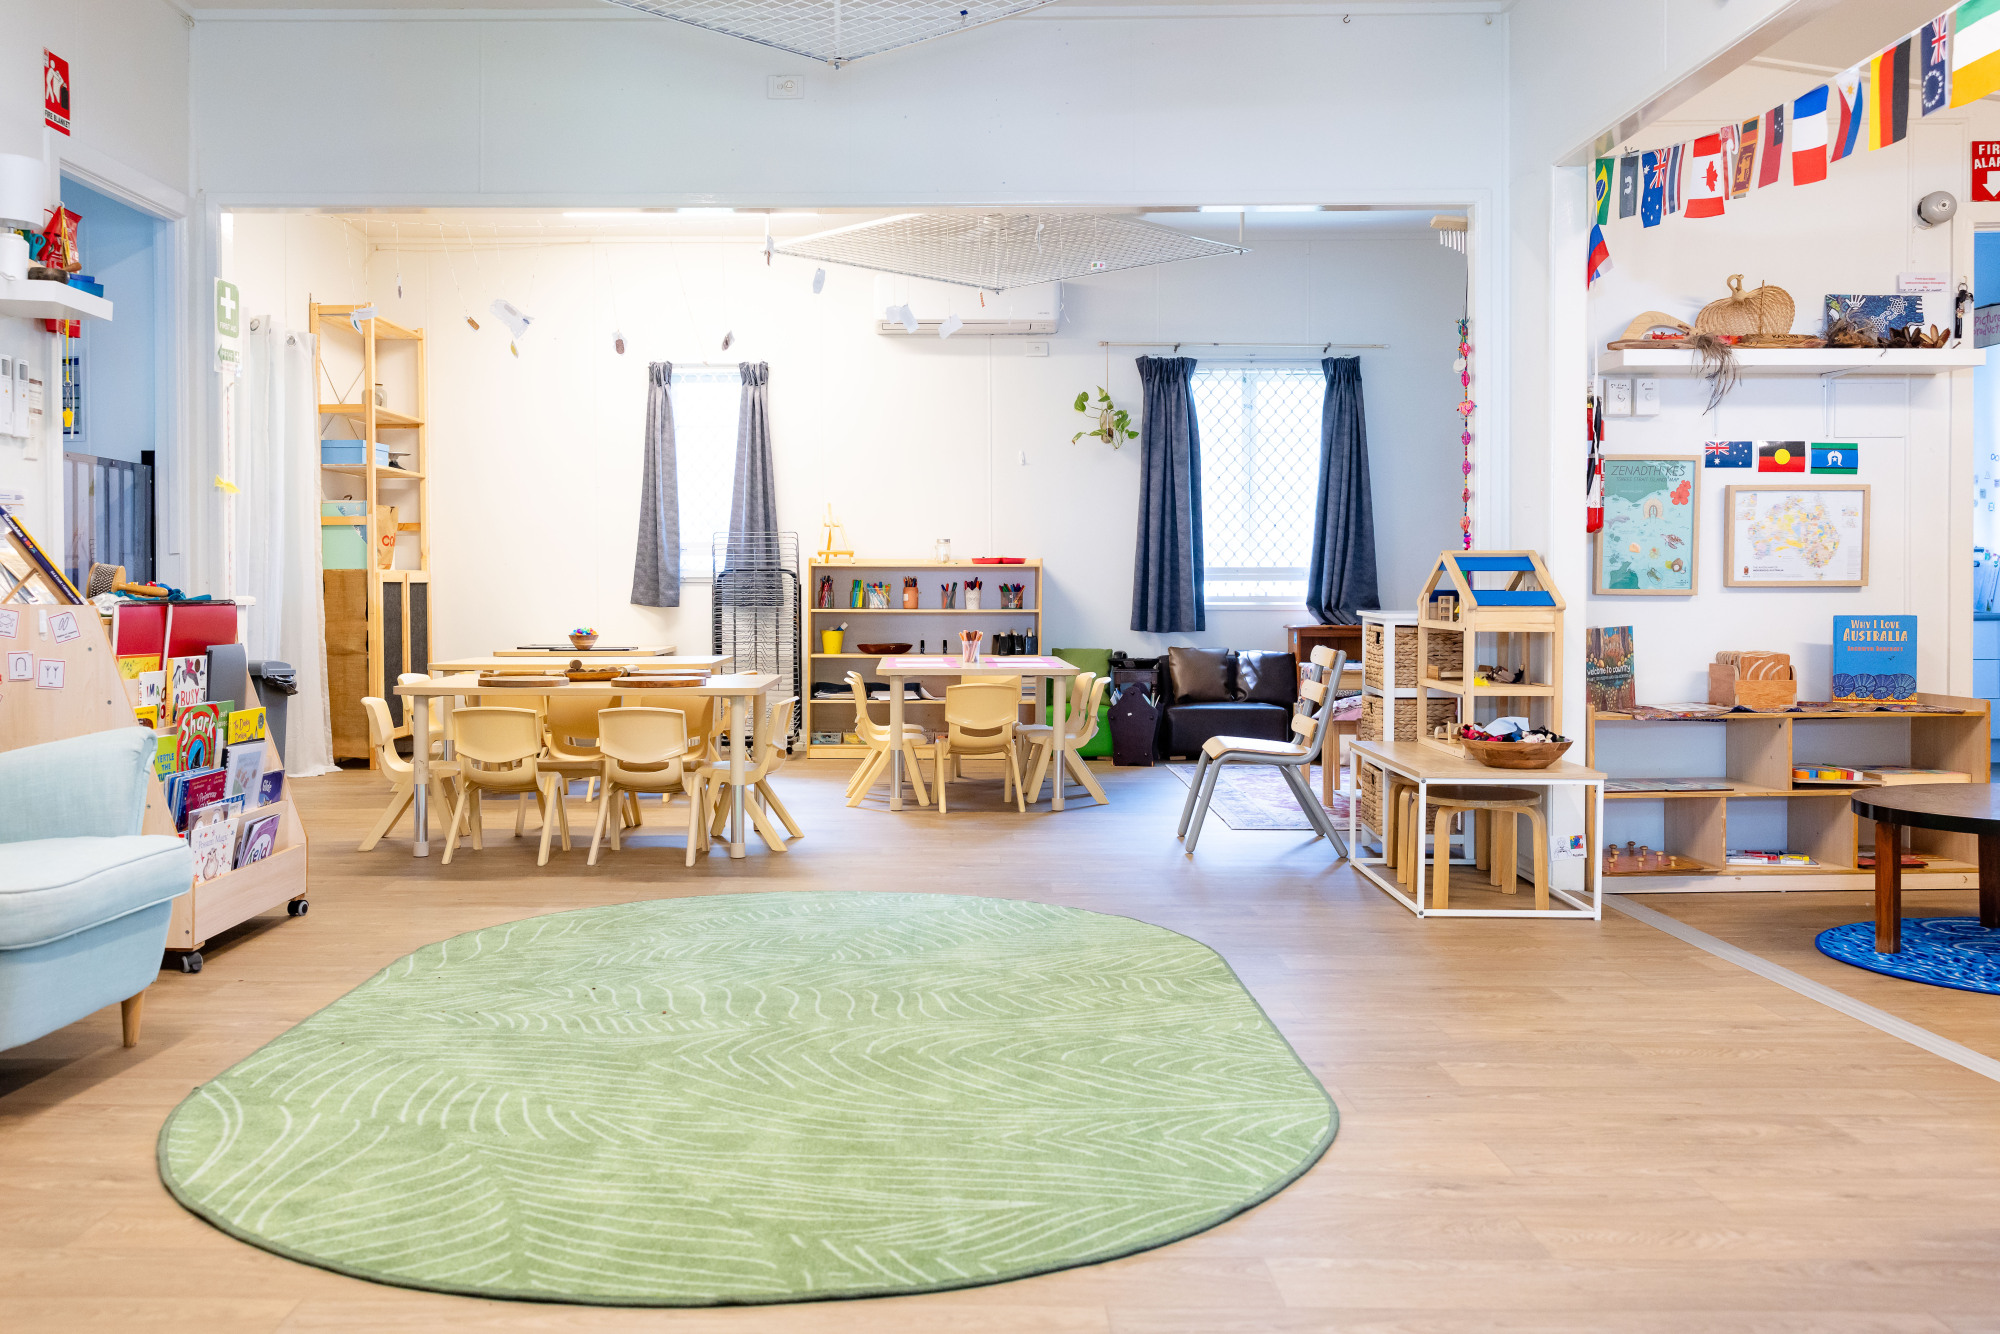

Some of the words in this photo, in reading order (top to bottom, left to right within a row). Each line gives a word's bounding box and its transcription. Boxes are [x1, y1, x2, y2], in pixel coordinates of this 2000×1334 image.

[45, 110, 53, 120] FIRE
[1611, 465, 1662, 476] ZENADTH
[1665, 465, 1687, 477] KES
[1851, 619, 1871, 629] WHY
[1873, 619, 1877, 629] I
[1880, 619, 1900, 629] LOVE
[1843, 628, 1908, 642] AUSTRALIA
[180, 687, 200, 707] BUSY
[181, 711, 216, 746] Shark
[156, 752, 175, 763] YERTLE
[161, 763, 171, 771] THE
